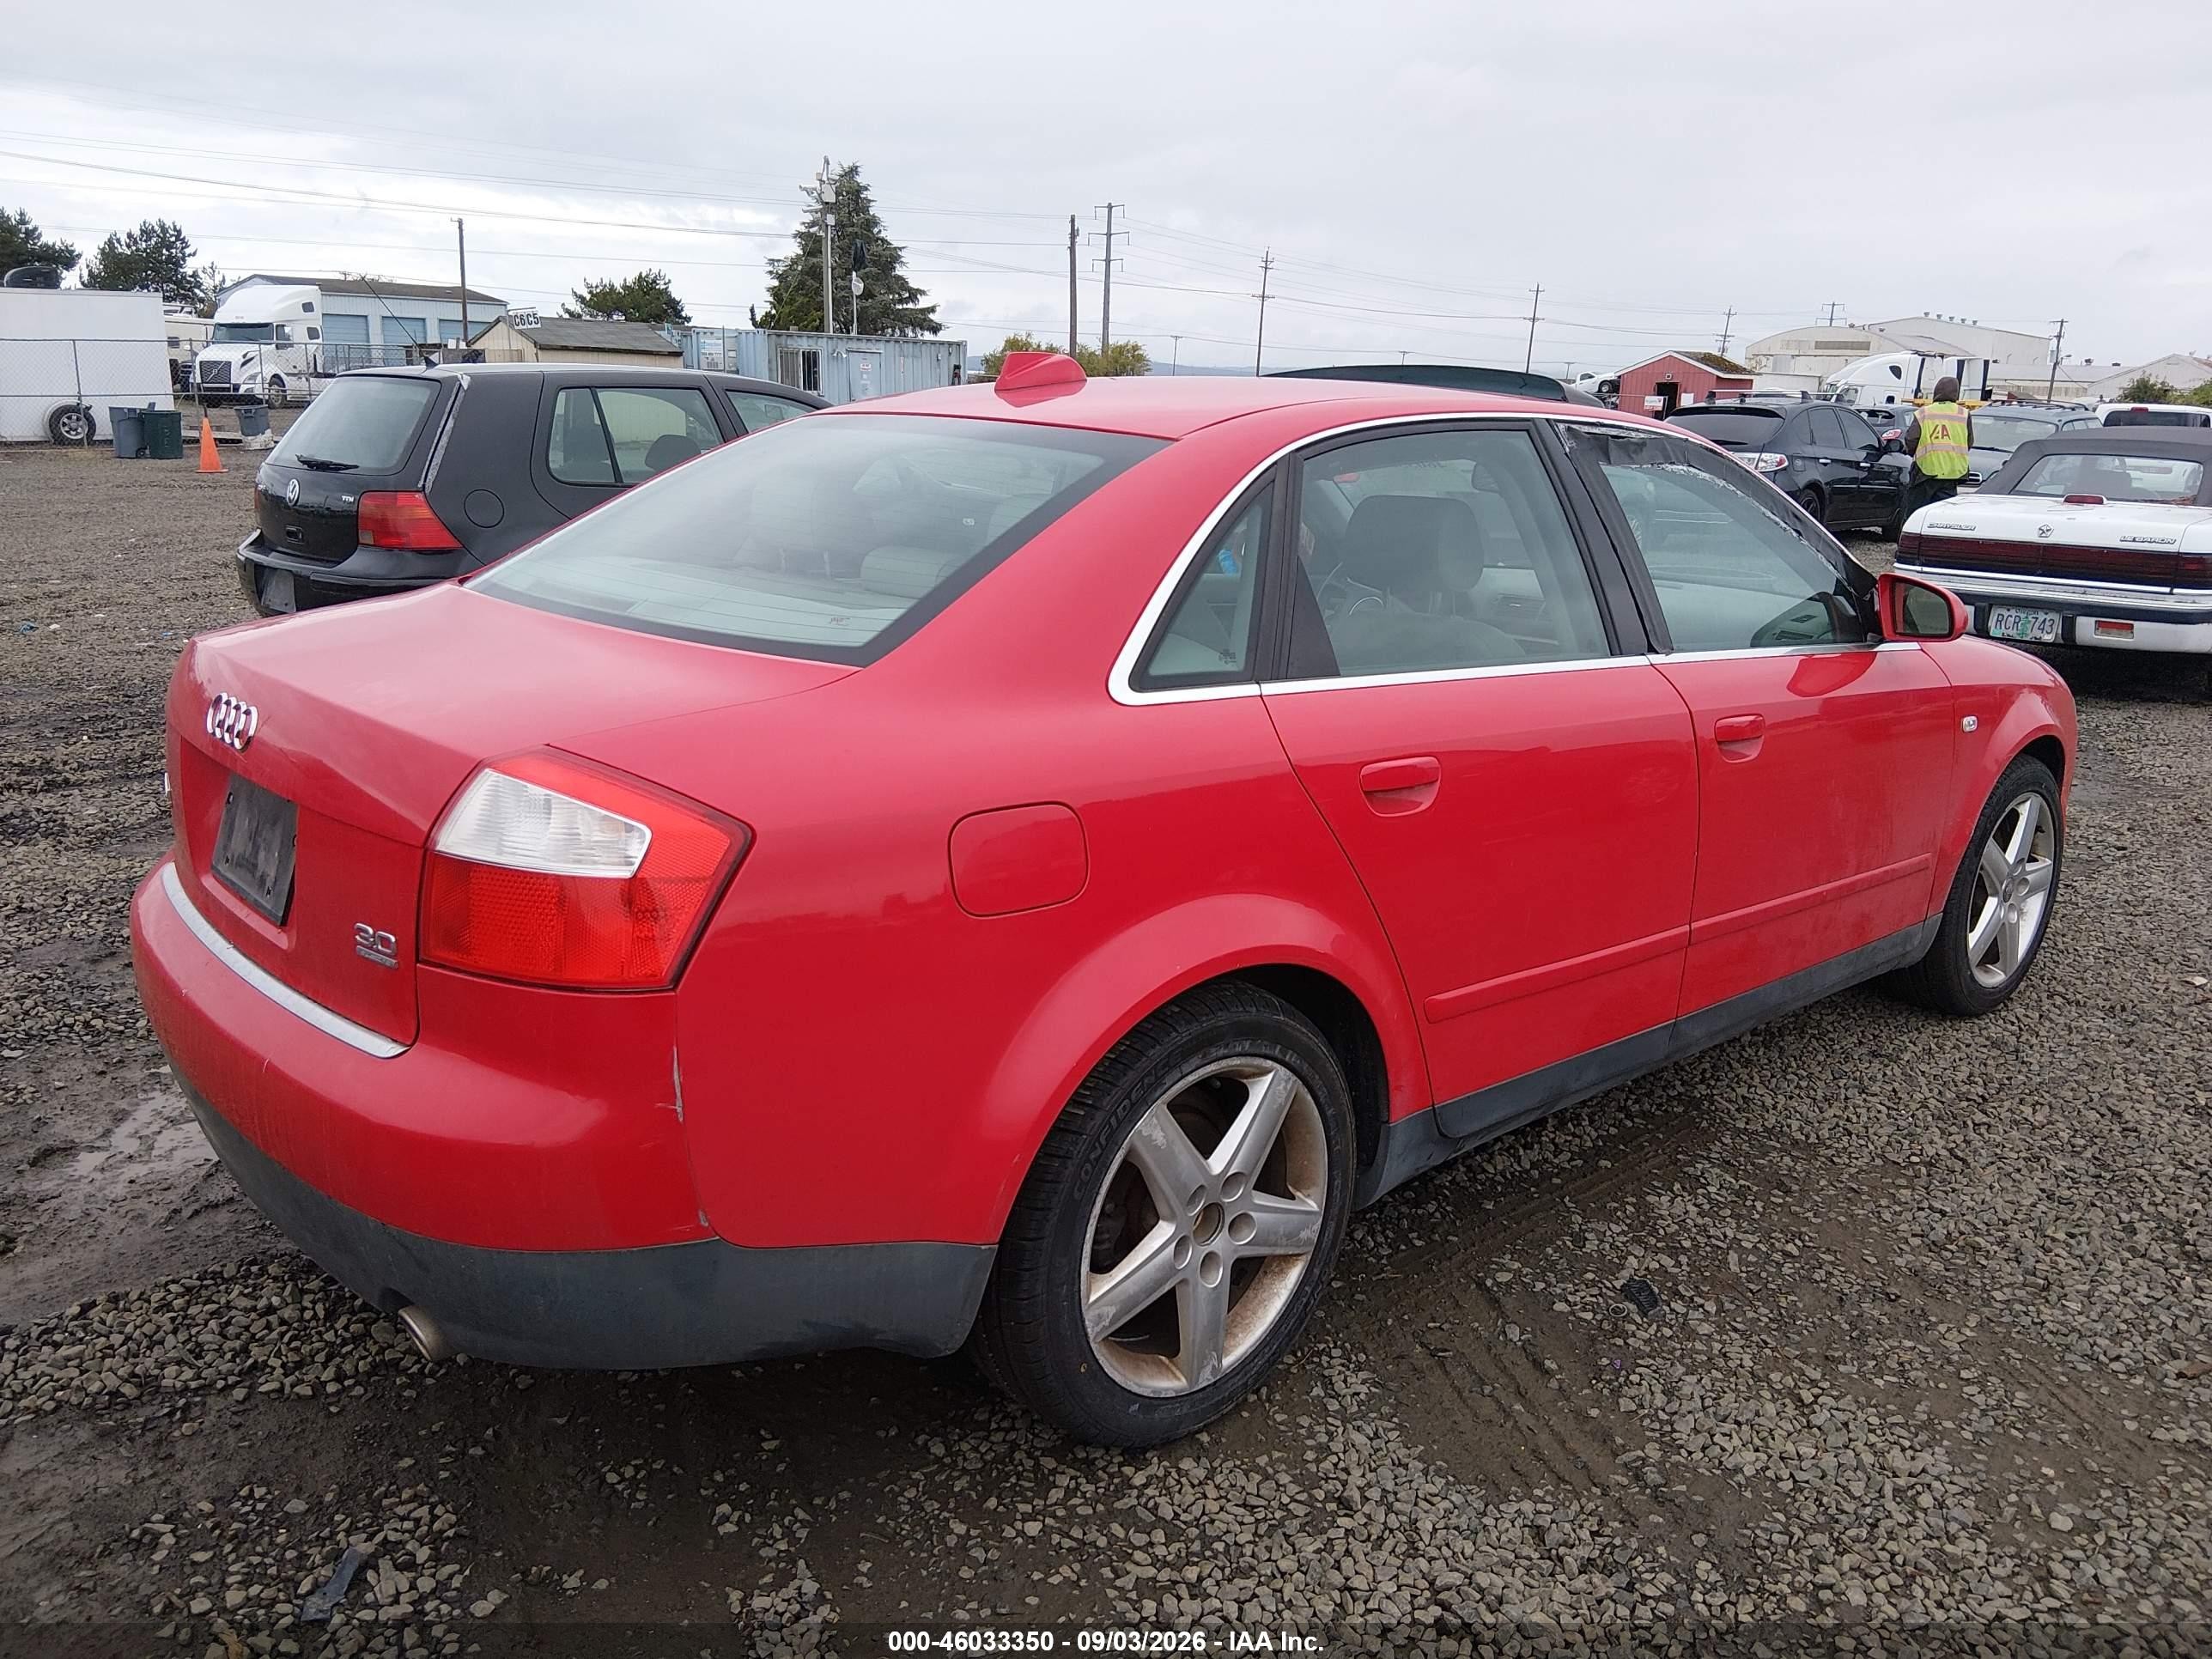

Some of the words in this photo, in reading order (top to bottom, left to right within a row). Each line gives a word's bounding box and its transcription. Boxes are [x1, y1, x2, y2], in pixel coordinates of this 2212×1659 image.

[514, 313, 526, 326] C6
[526, 313, 539, 325] C5
[1994, 613, 2022, 631] RCR
[2030, 616, 2055, 635] 743
